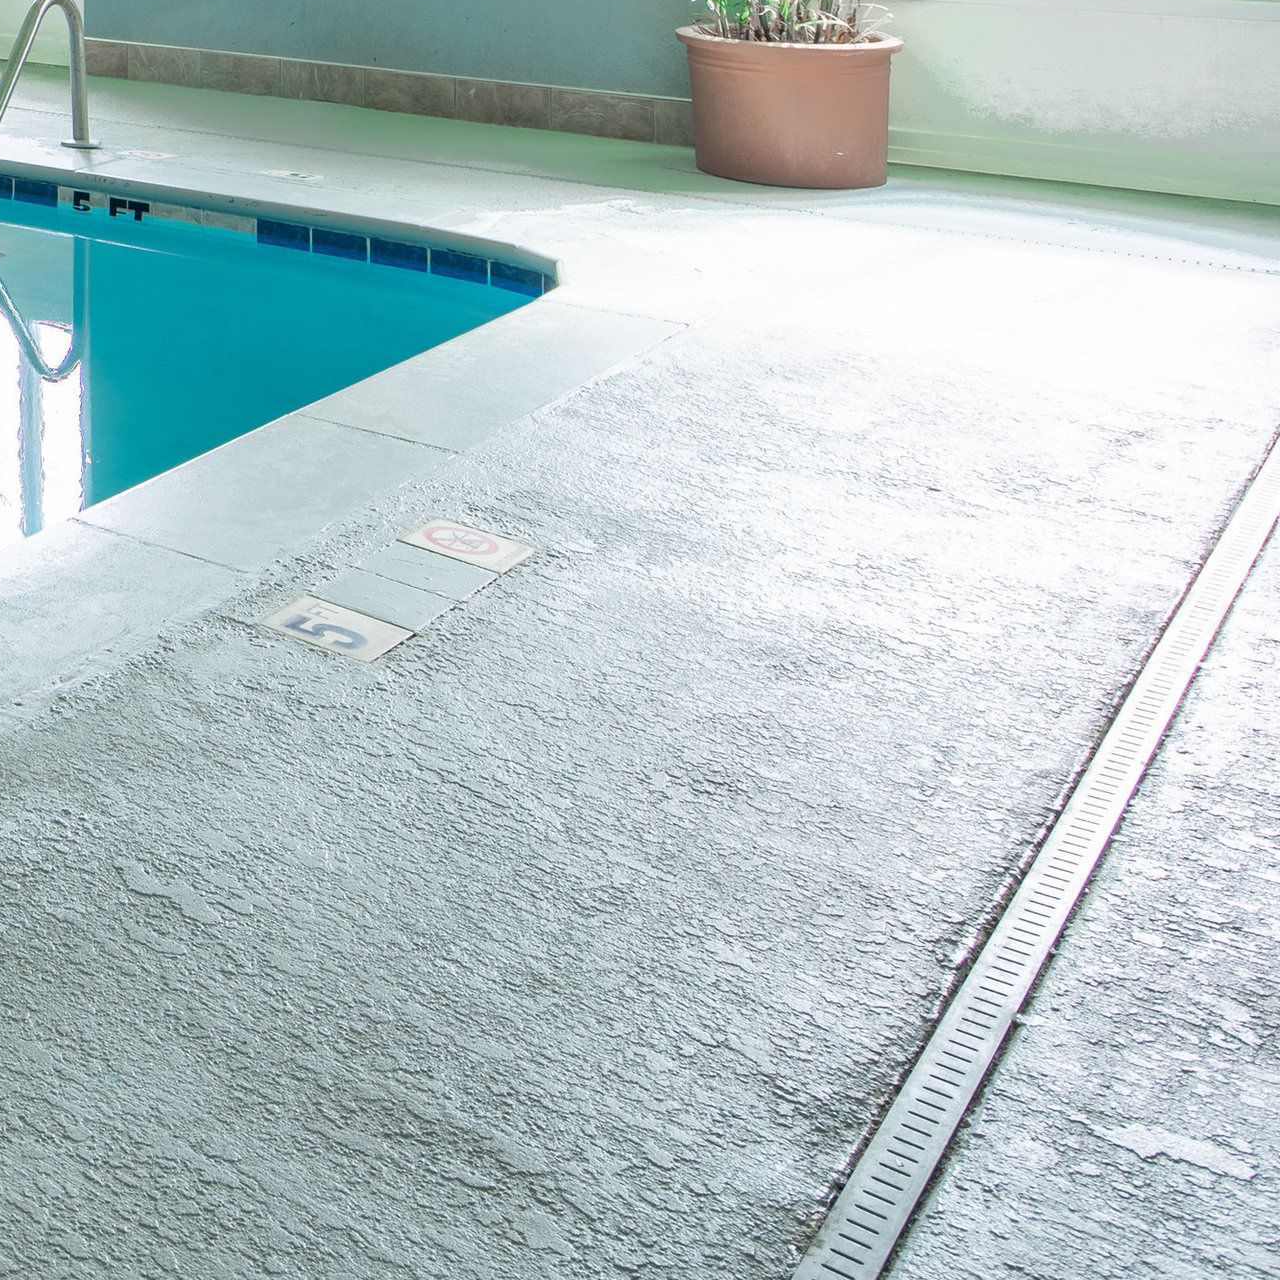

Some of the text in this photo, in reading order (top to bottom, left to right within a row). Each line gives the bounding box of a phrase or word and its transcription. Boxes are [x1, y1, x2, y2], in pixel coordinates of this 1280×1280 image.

[73, 191, 150, 221] 5 FT
[307, 604, 340, 620] FT
[285, 614, 368, 649] 5
